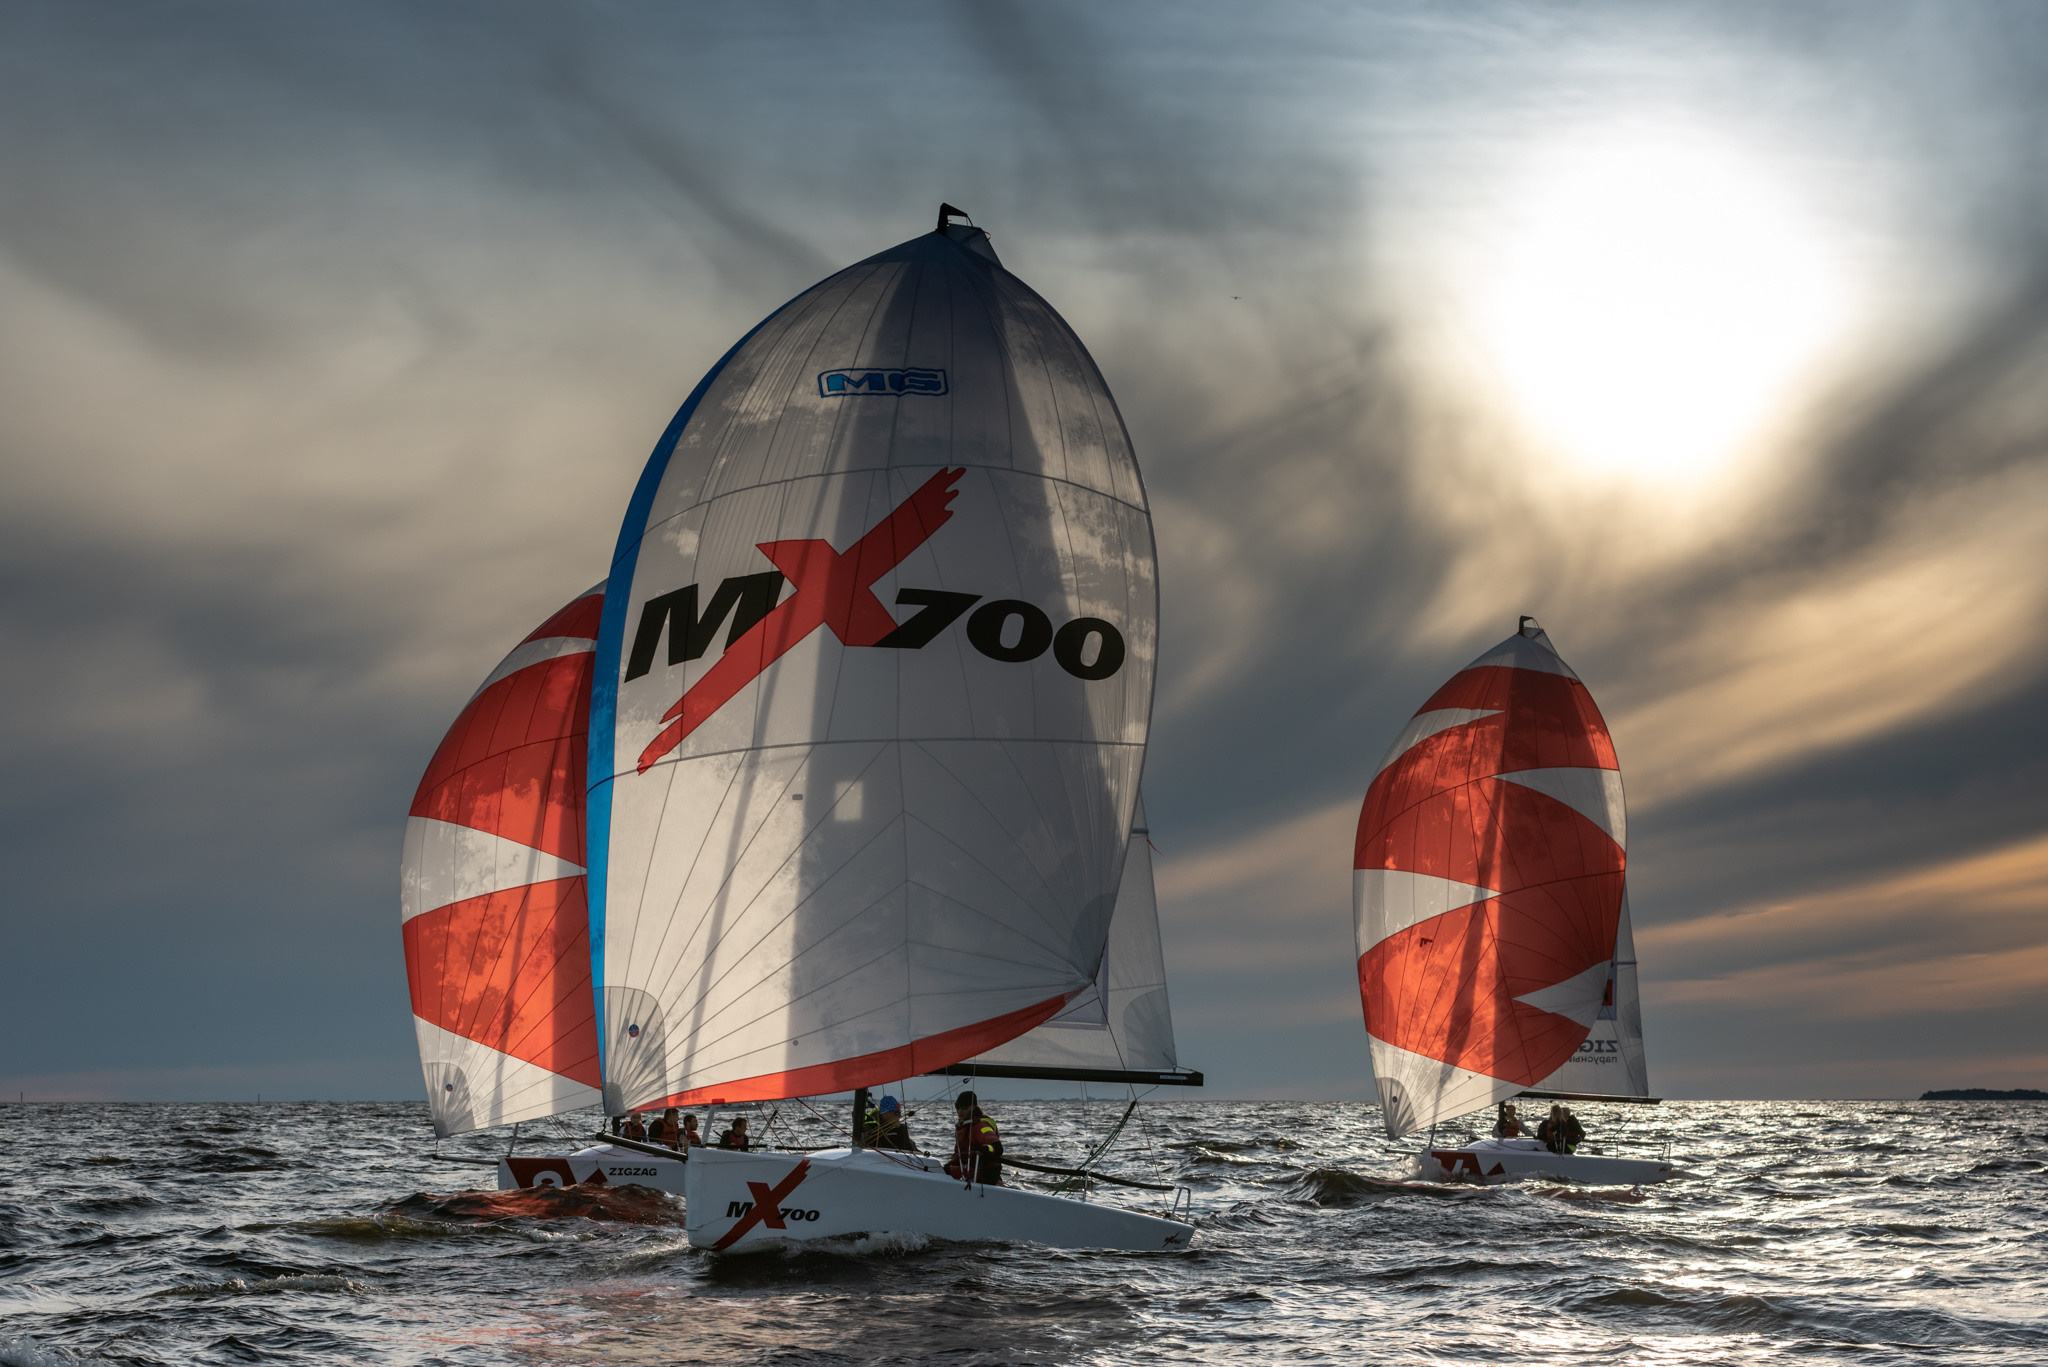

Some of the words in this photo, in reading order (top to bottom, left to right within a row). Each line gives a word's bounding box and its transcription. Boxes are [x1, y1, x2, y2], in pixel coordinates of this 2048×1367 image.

[826, 372, 942, 392] MG
[624, 466, 1125, 776] MX700
[608, 1167, 658, 1177] ZIGZAG
[711, 1159, 820, 1252] MX700
